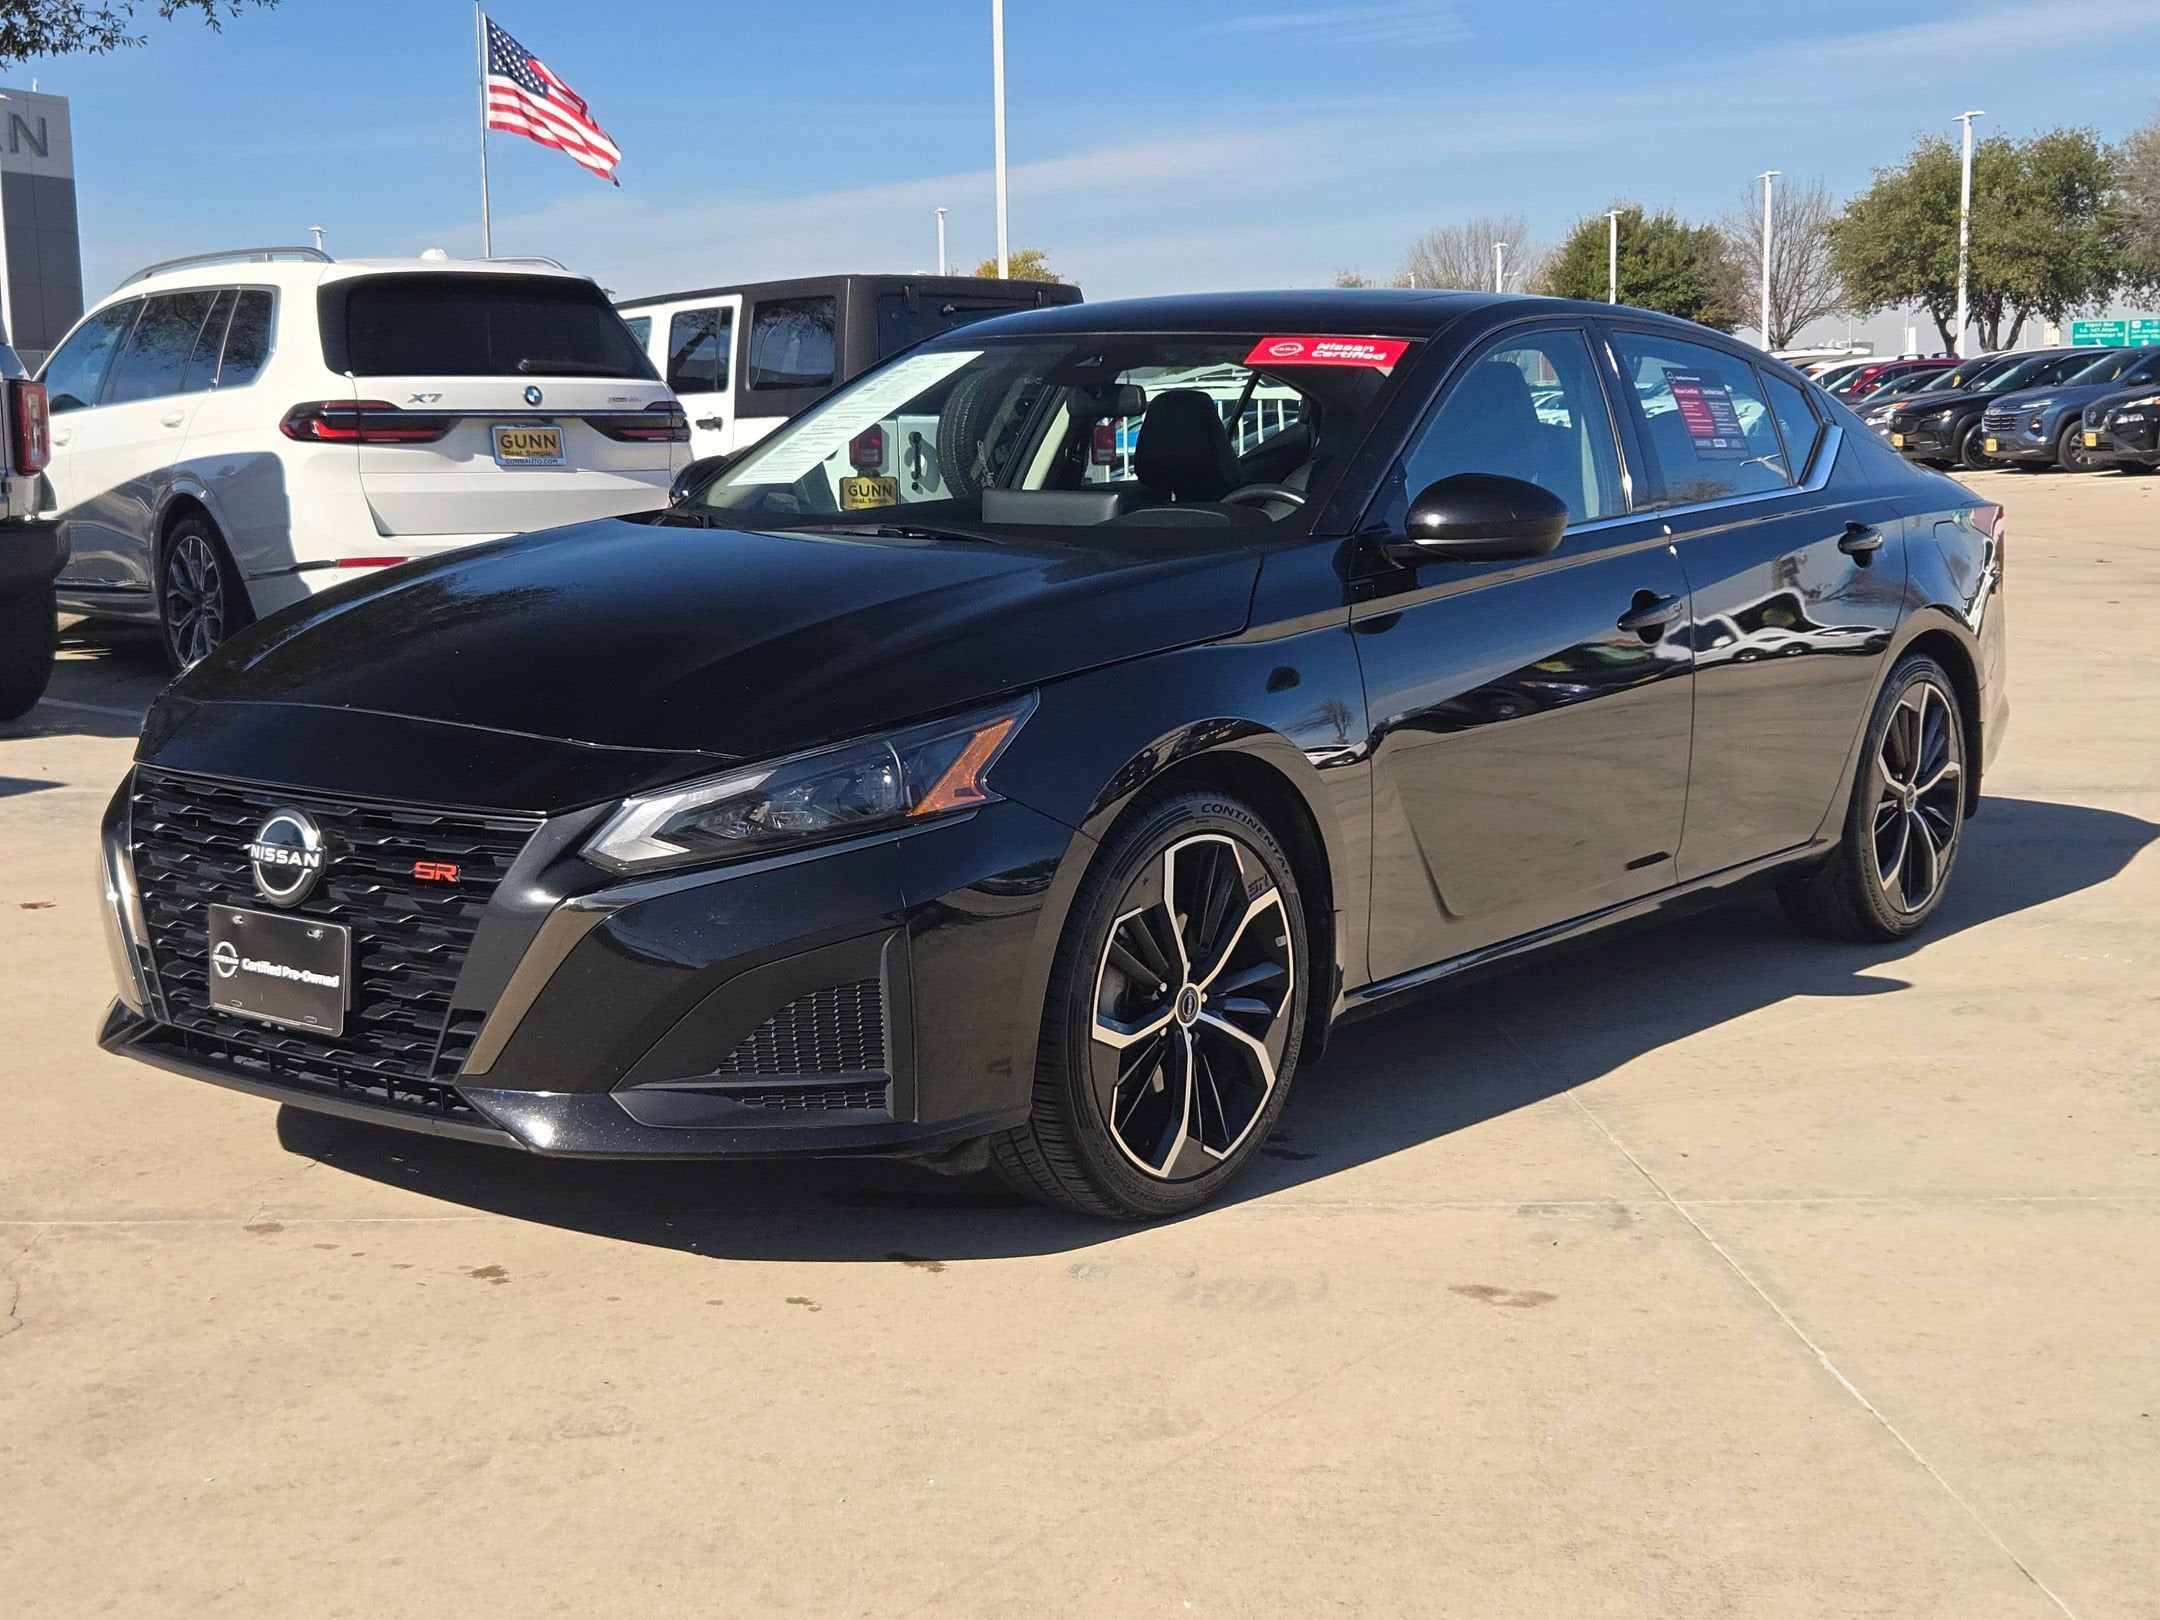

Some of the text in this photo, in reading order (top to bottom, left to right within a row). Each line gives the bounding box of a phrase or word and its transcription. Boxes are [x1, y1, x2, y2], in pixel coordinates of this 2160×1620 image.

[0, 112, 48, 157] N
[1311, 351, 1387, 360] Certified
[1316, 343, 1375, 352] Nissan
[405, 393, 443, 403] X7
[500, 434, 557, 449] GUNN
[848, 484, 892, 497] GUNN
[1201, 803, 1289, 875] CONTINENTAL
[251, 846, 320, 868] NISSAN
[414, 861, 460, 883] SR
[241, 957, 340, 988] Certified Pre-Owned
